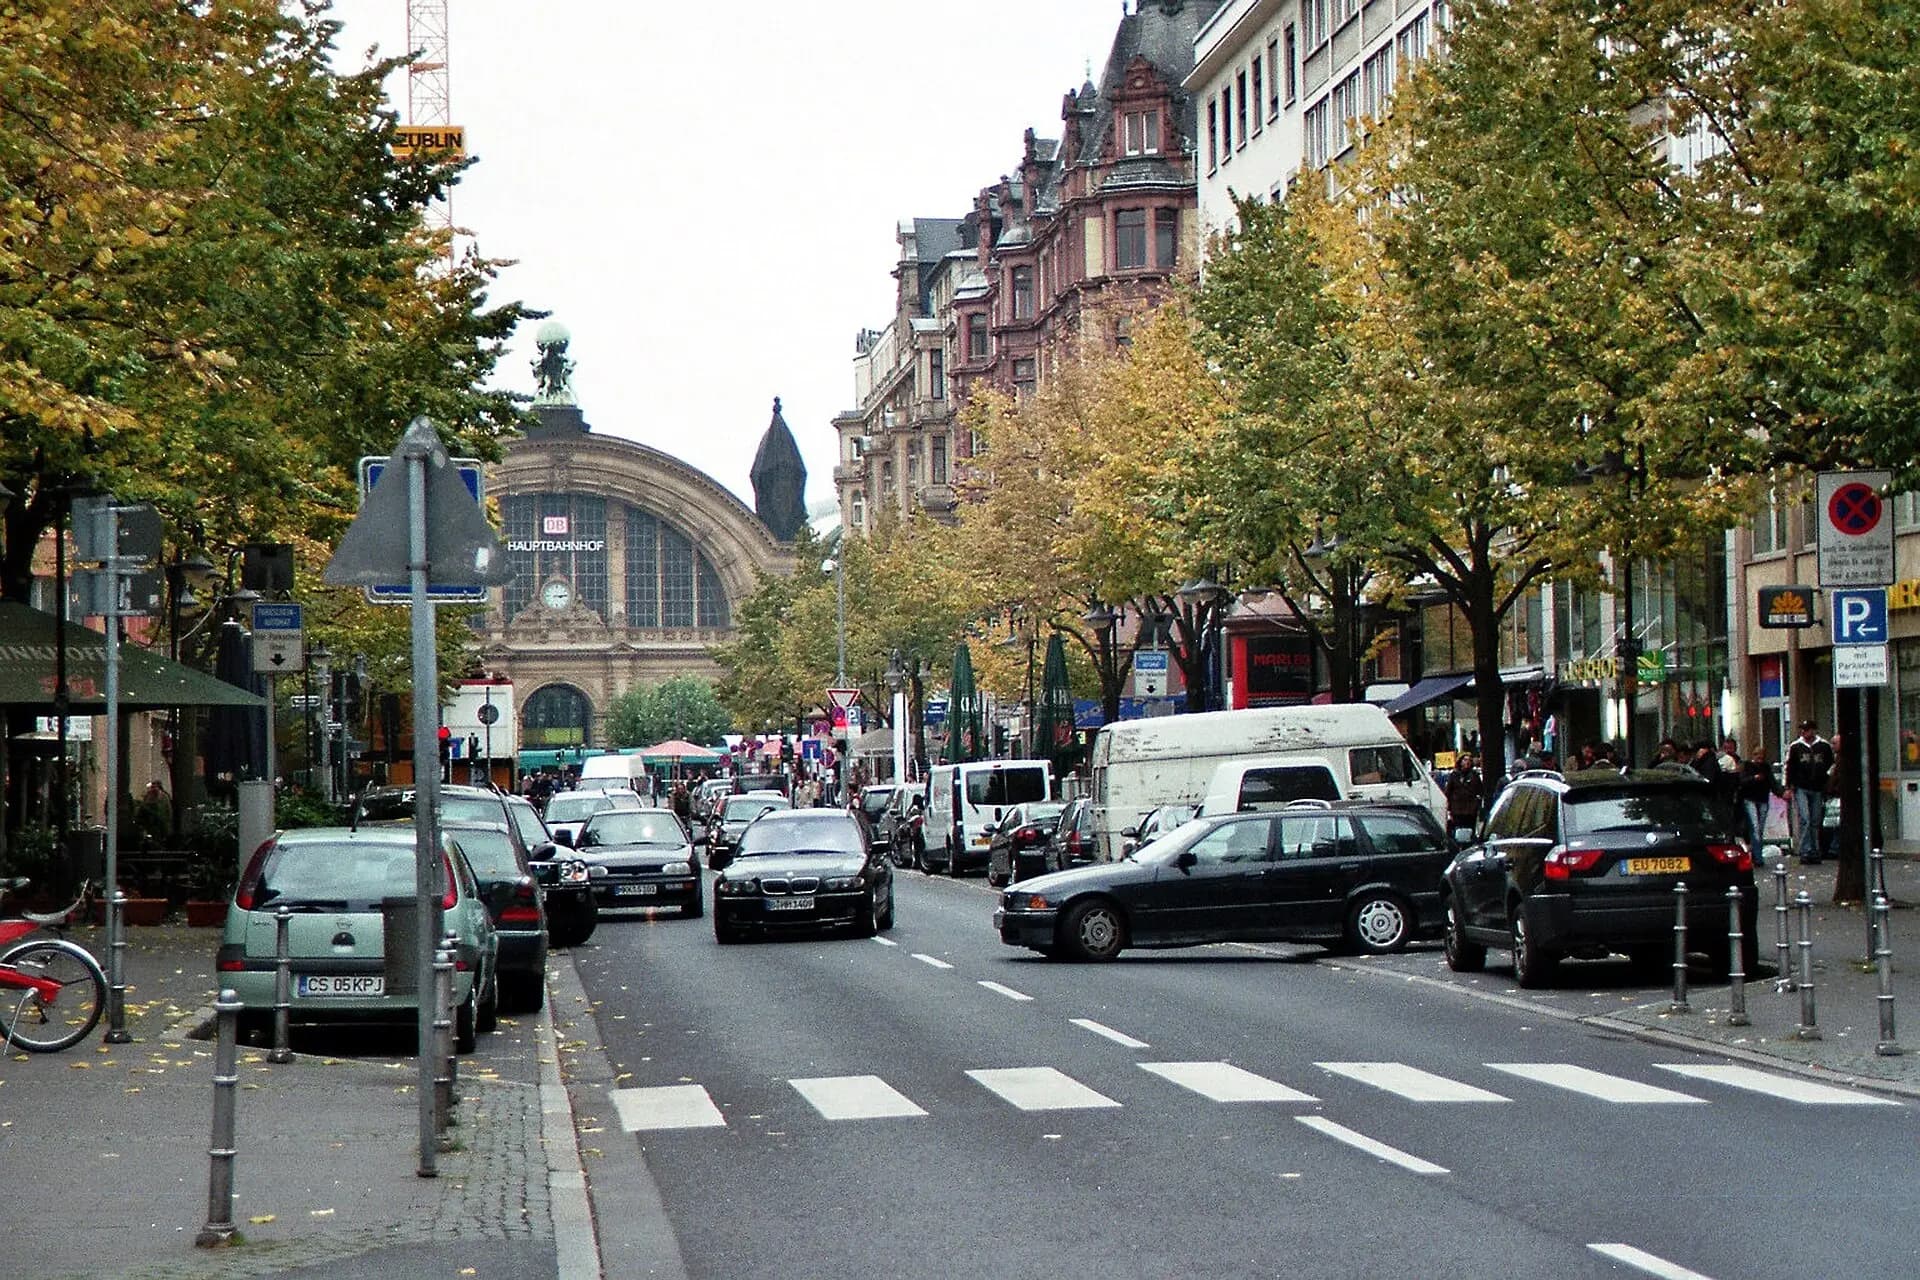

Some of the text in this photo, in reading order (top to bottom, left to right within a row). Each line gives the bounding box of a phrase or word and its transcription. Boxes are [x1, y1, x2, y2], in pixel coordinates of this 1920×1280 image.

[507, 541, 604, 551] HAUPTBAHNHOF
[1842, 597, 1871, 637] P
[1651, 859, 1683, 869] 7082
[308, 978, 328, 991] CS
